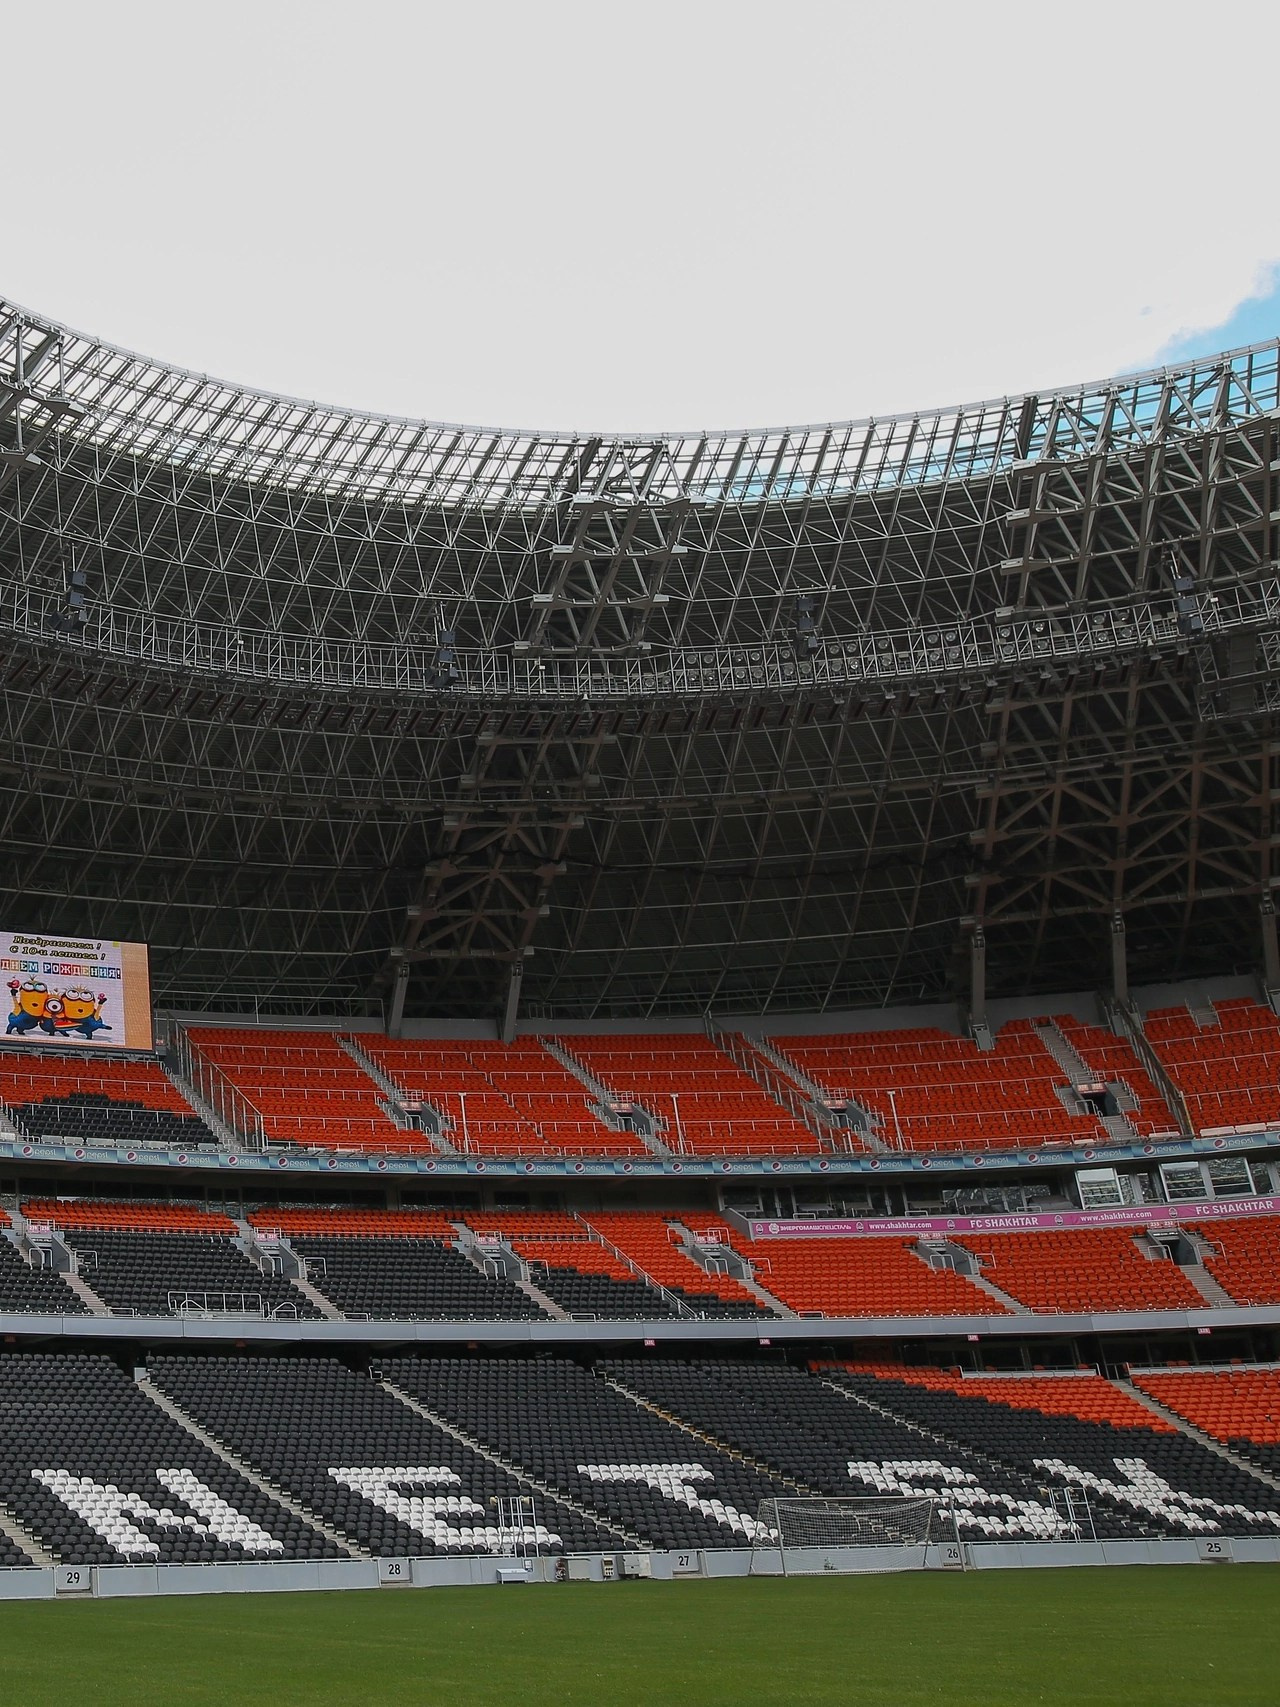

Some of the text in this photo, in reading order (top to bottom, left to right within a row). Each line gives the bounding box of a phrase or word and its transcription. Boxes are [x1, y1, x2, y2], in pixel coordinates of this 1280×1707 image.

[13, 935, 94, 950] Поздравляем
[50, 950, 99, 960] летием
[43, 962, 121, 979] РОЖДЕНИЯ!
[1228, 1136, 1254, 1149] pepsi
[1098, 1149, 1122, 1160] pepsi
[1156, 1144, 1182, 1155] pepsi
[933, 1158, 955, 1169] pepsi
[987, 1156, 1009, 1167] pepsi
[1041, 1153, 1063, 1164] pepsi
[882, 1160, 903, 1169] pepsi
[1196, 1201, 1274, 1215] FC SHAKHTAR
[1080, 1210, 1152, 1222] www.shakhtar.com
[869, 1221, 932, 1232] www.shakhtar.com
[970, 1216, 1039, 1228] FC SHAKHTAR
[947, 1548, 959, 1559] 26
[1206, 1543, 1222, 1553] 25
[678, 1555, 689, 1566] 27
[388, 1564, 401, 1575] 28
[67, 1572, 80, 1584] 29
